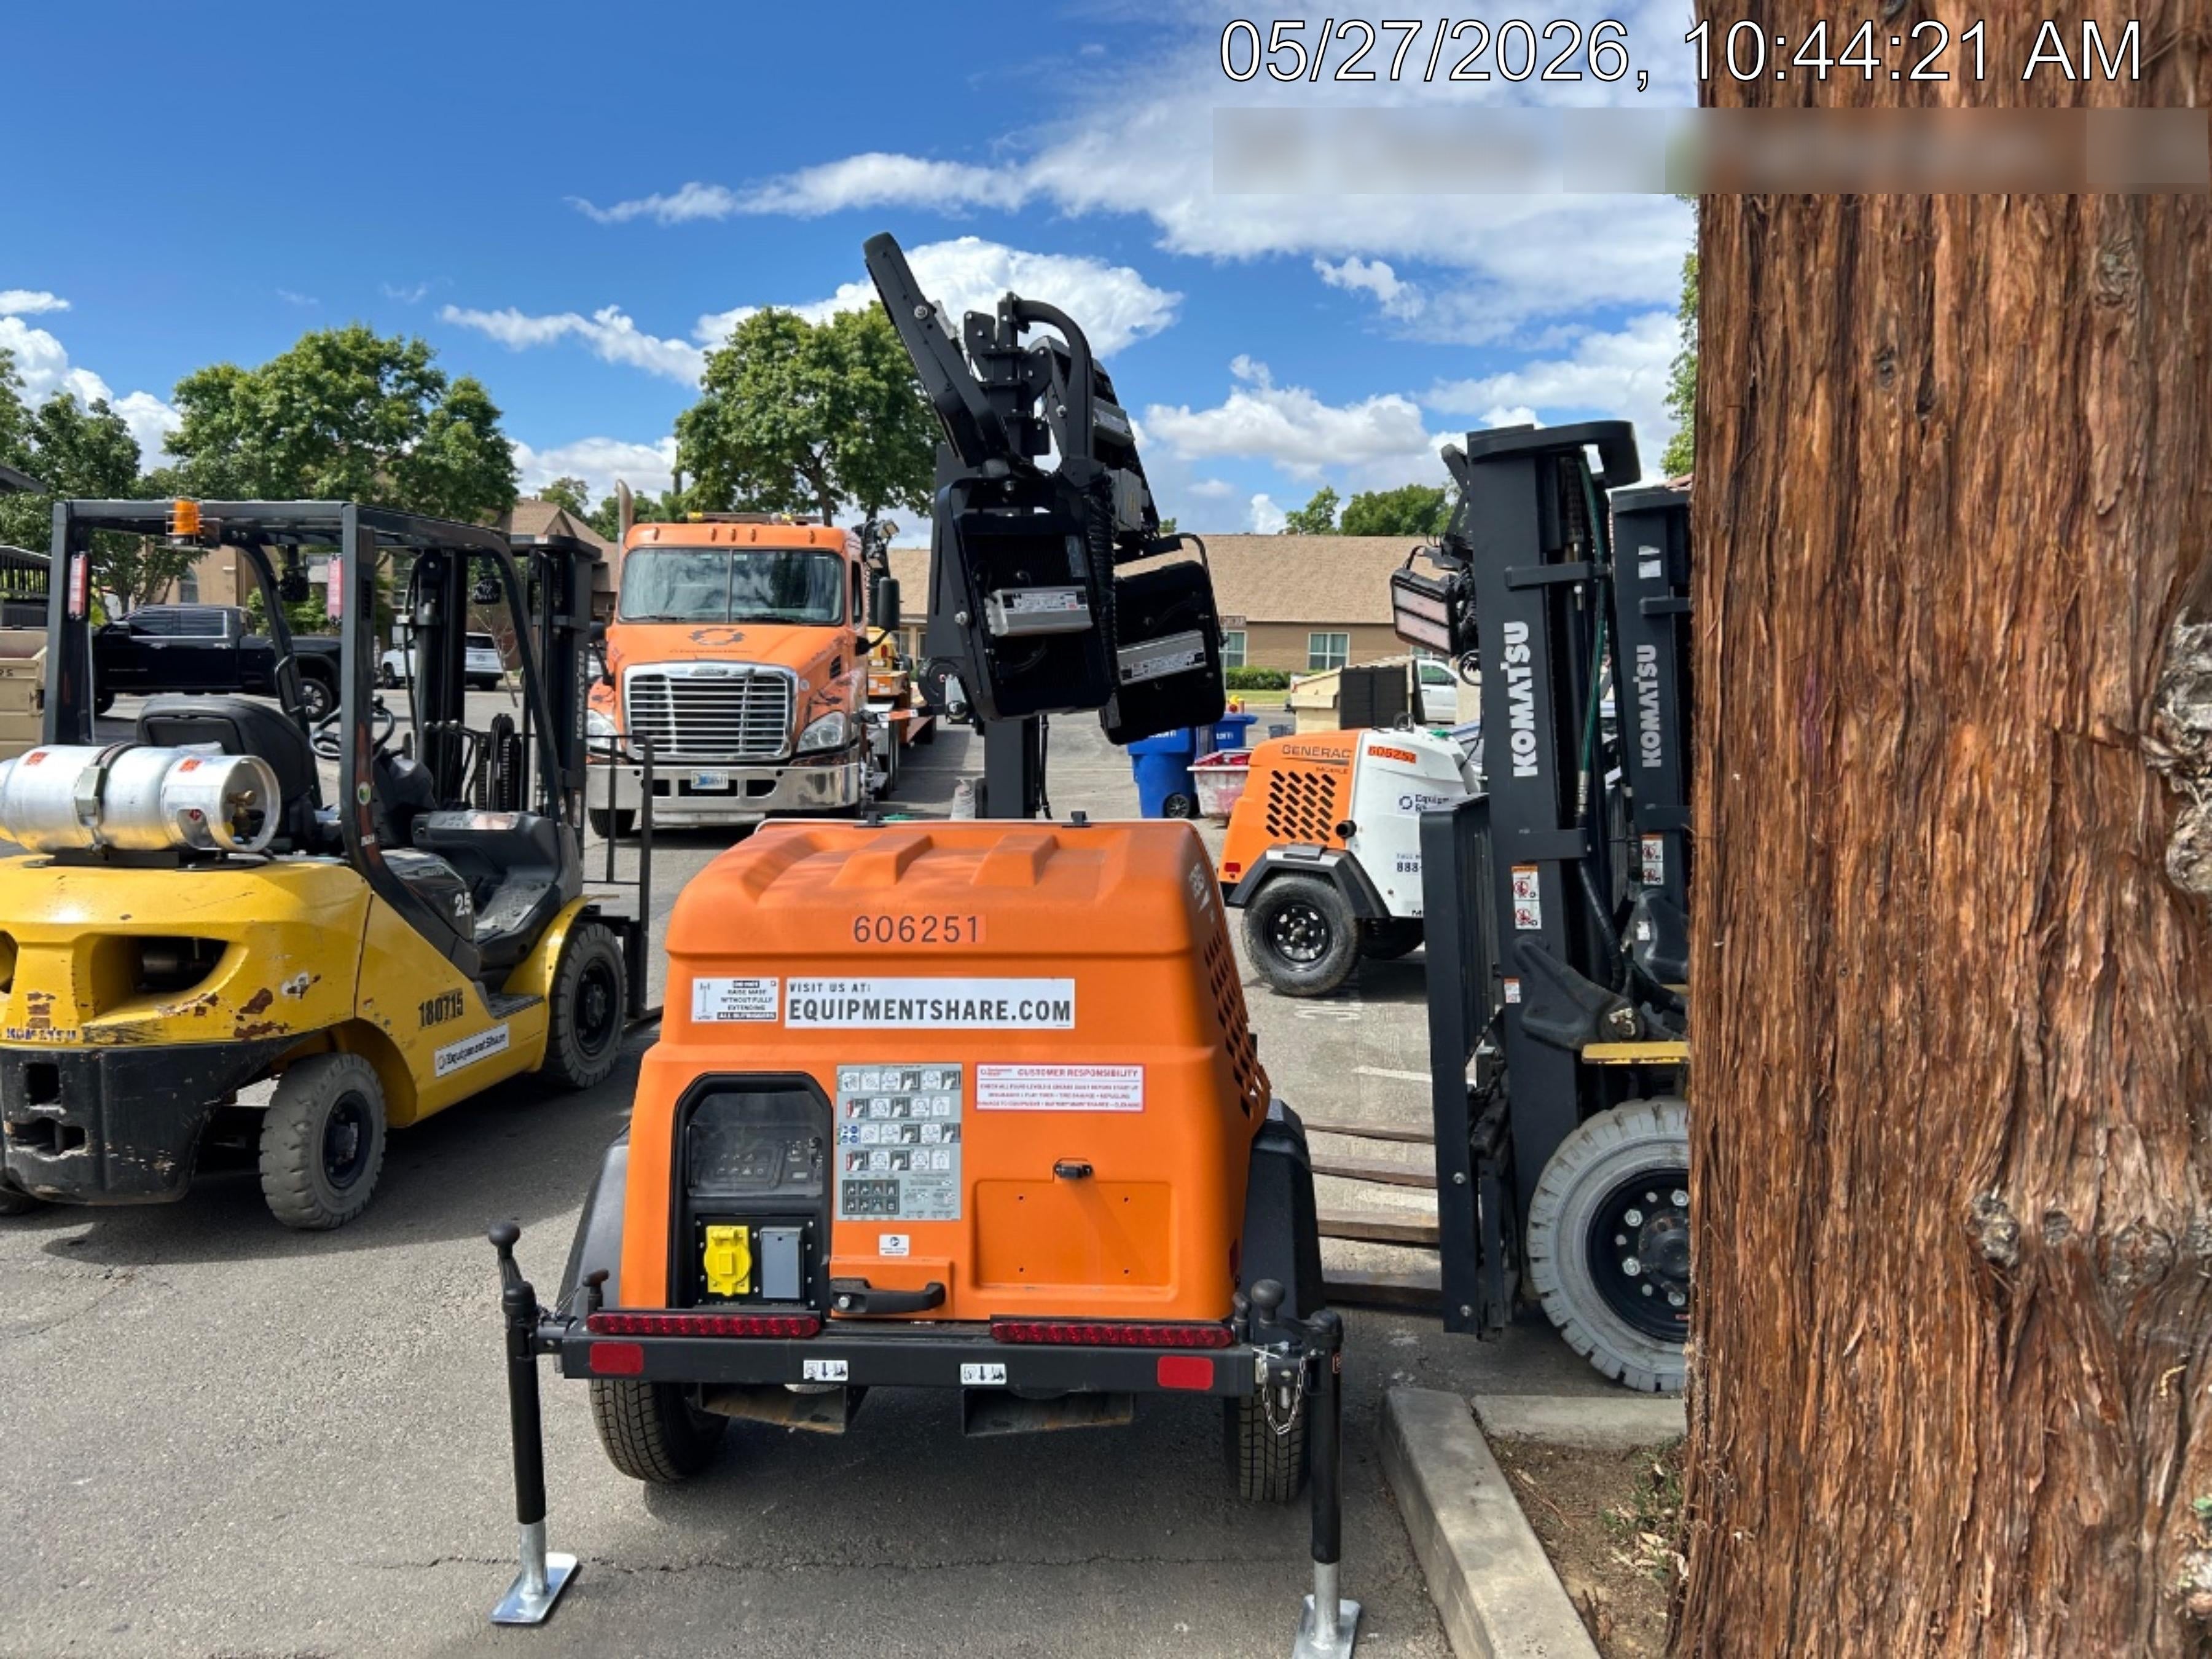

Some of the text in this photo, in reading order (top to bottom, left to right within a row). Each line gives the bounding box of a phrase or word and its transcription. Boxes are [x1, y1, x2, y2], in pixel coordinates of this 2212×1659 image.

[1500, 621, 1538, 777] KOMATSU
[1633, 645, 1661, 767] KOMATSU
[1282, 744, 1352, 758] GENERAC
[455, 892, 472, 917] 25
[855, 916, 978, 943] 606251
[789, 983, 871, 993] VISIT US AT:
[418, 990, 463, 1027] 180715
[789, 998, 1071, 1022] EQUIPMENTSHARE.COM
[1017, 1069, 1066, 1077] CUSTOMER
[1067, 1069, 1138, 1077] RESPONSIBILITY
